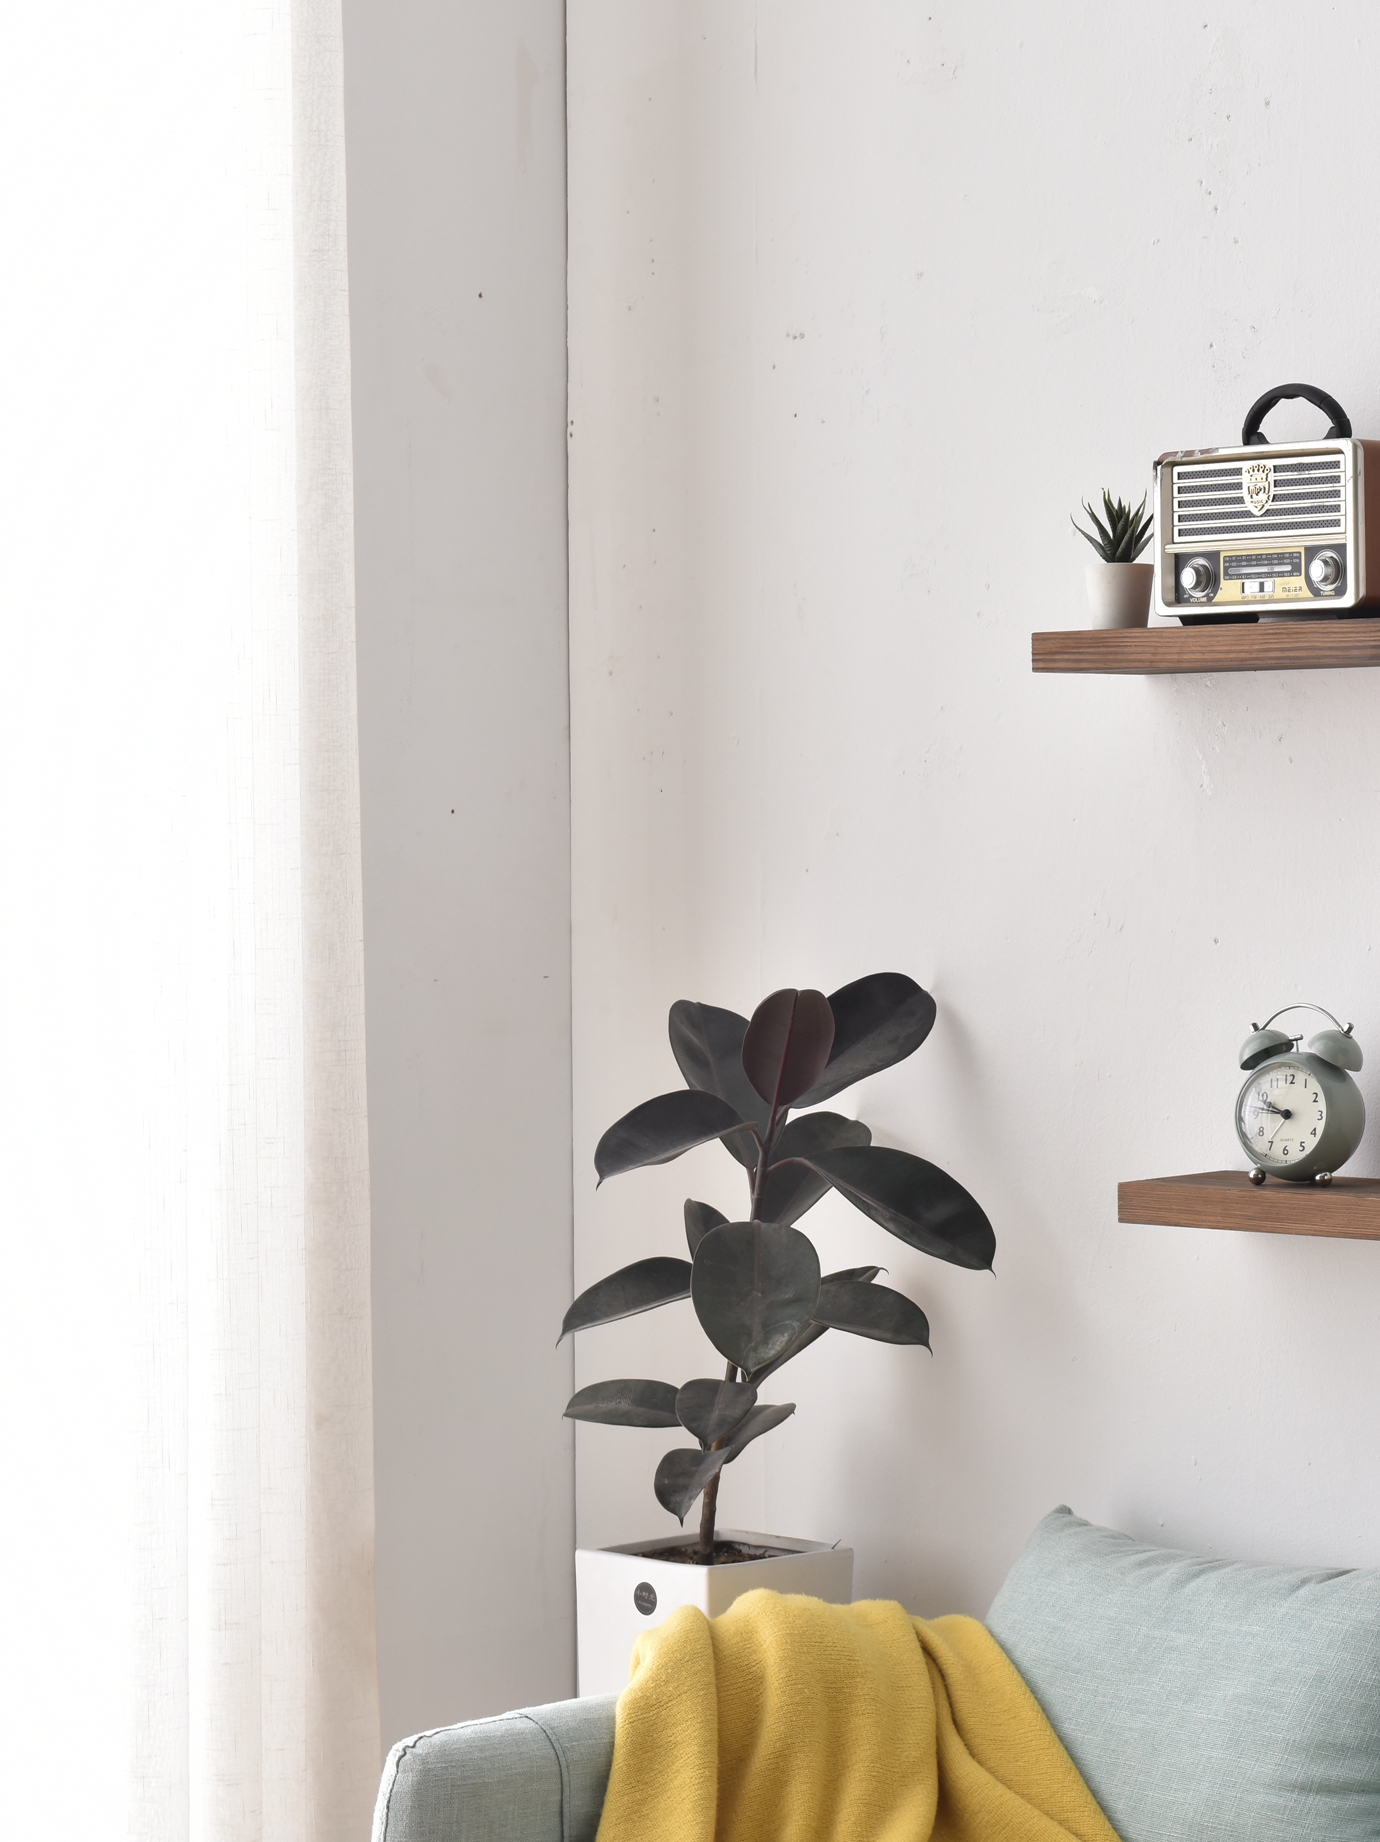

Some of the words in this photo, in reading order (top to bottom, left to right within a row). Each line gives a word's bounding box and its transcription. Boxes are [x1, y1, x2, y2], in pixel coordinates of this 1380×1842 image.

[1269, 1078, 1279, 1089] 11
[1284, 1074, 1296, 1085] 12
[1304, 1078, 1308, 1089] 1
[1257, 1091, 1269, 1103] 10
[1312, 1092, 1319, 1103] 2
[1252, 1109, 1260, 1120] 9
[1317, 1110, 1323, 1121] 3
[1258, 1126, 1265, 1137] 8
[1310, 1127, 1317, 1138] 4
[1267, 1140, 1274, 1151] 7
[1282, 1145, 1289, 1156] 6
[1299, 1141, 1305, 1152] 5
